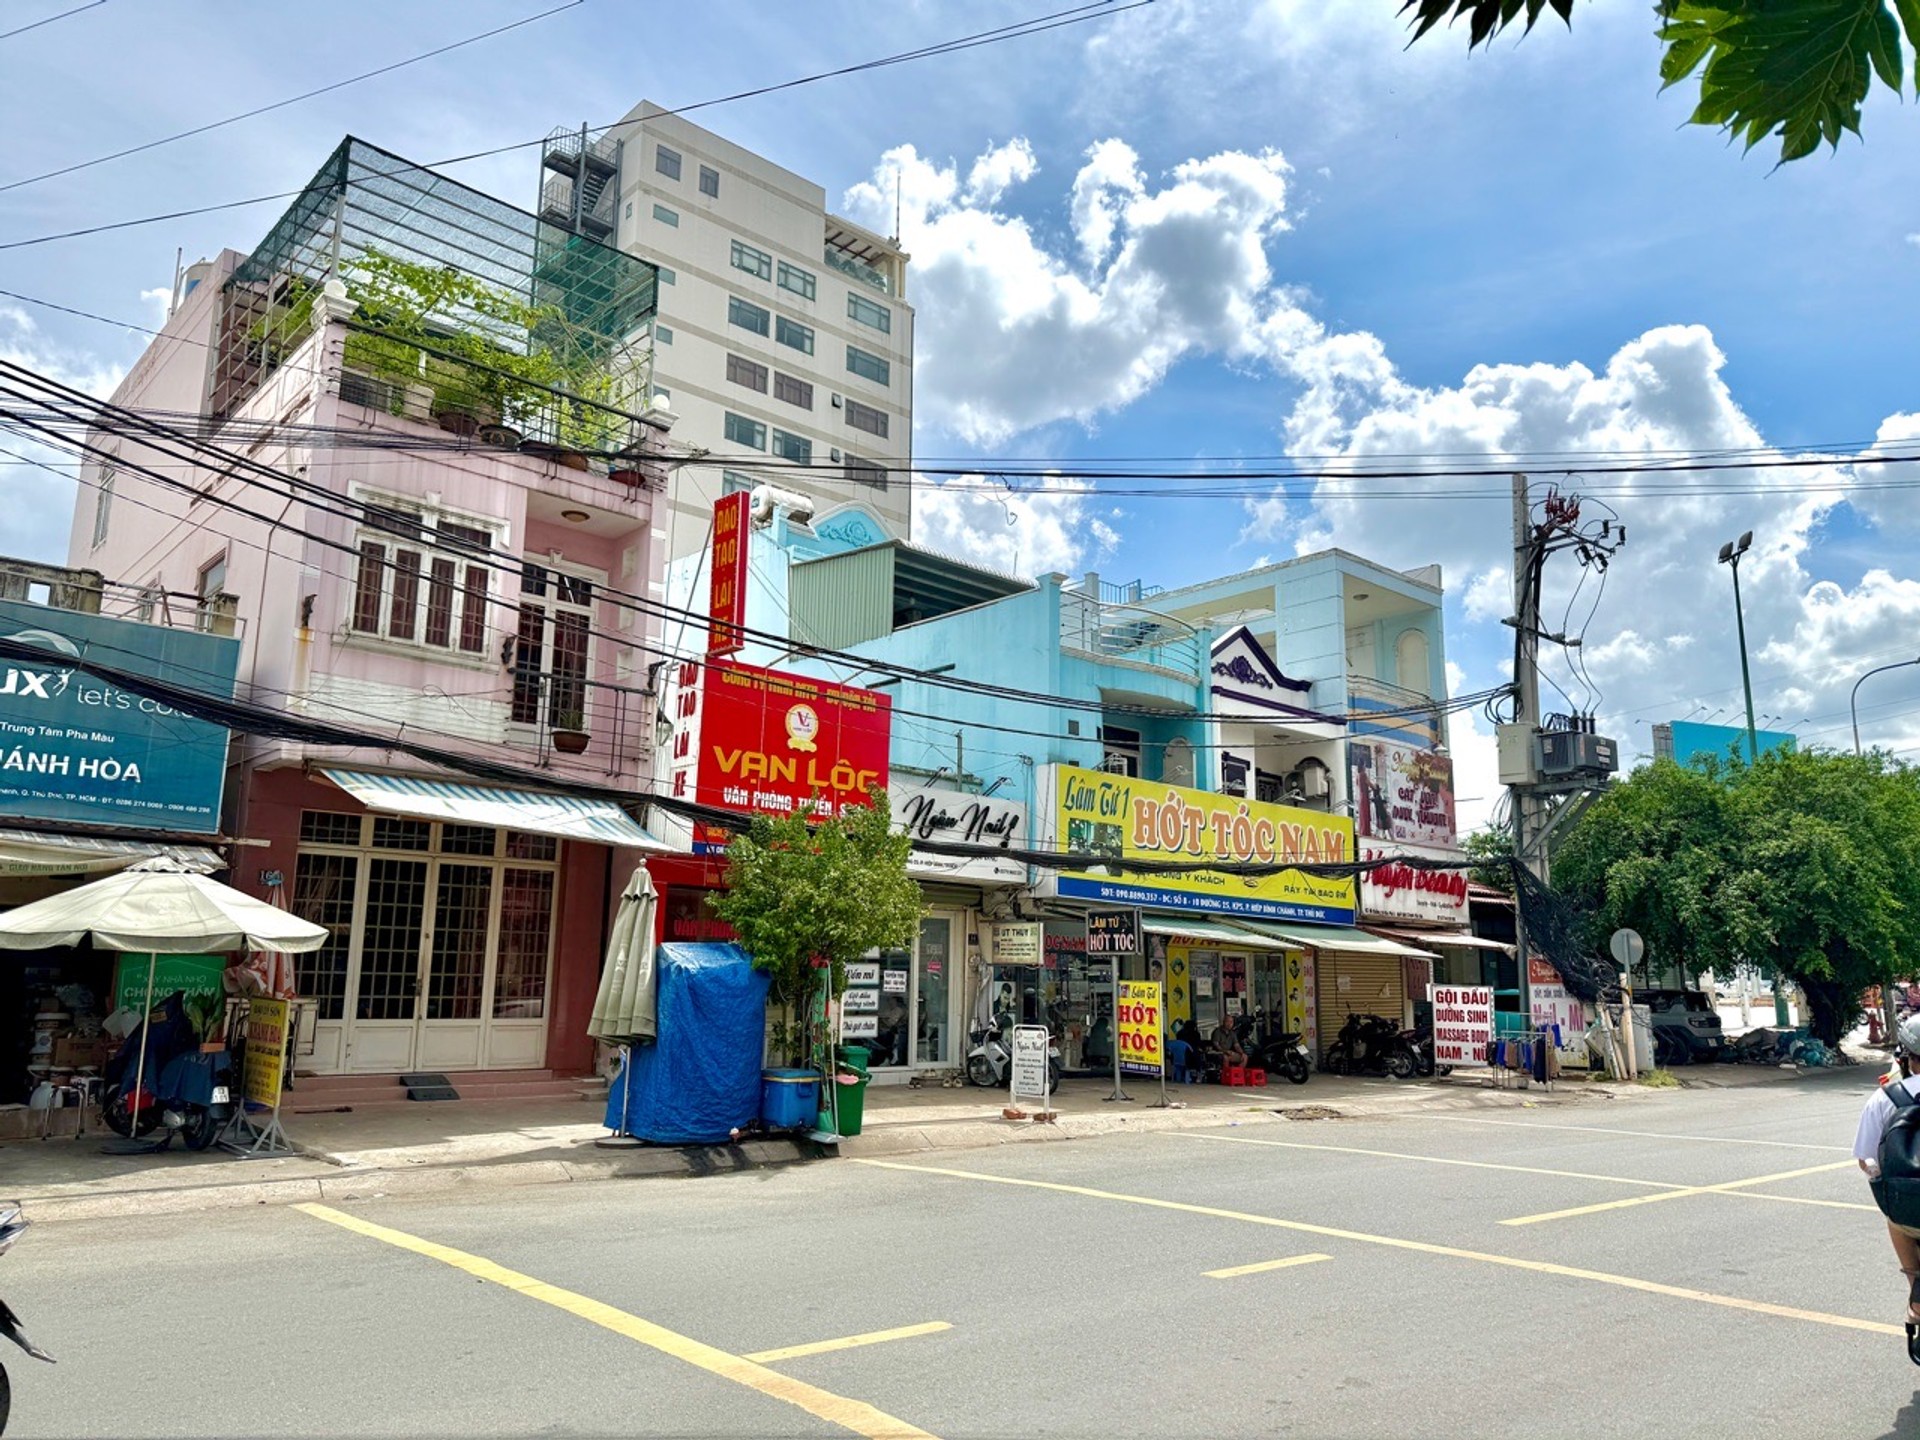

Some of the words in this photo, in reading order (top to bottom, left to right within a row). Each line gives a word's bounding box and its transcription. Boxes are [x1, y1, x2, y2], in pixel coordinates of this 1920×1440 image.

[717, 503, 737, 536] ĐÀO
[715, 538, 736, 571] TẠO
[77, 684, 131, 710] let's
[1, 721, 35, 737] Trung
[38, 724, 64, 738] Tâm
[66, 728, 89, 741] Pha
[91, 731, 115, 744] Màu
[0, 746, 70, 776] ÁNH
[78, 756, 142, 784] HÒA
[713, 745, 797, 785] VẠN
[807, 759, 880, 796] LỘC
[674, 771, 687, 797] XE
[1062, 775, 1096, 812] Lâm
[723, 786, 749, 806] VĂN
[752, 790, 792, 811] PHÒNG
[1131, 789, 1206, 858] HỚT
[1209, 802, 1276, 864] TÓC
[1279, 823, 1347, 865] NAM
[1090, 930, 1111, 951] HỚT
[1113, 929, 1135, 951] TÓC
[124, 986, 174, 998] CHNG
[1435, 989, 1458, 1005] GỘI
[1461, 987, 1488, 1005] ĐẦU
[1117, 1000, 1158, 1026] HỚT
[1467, 1010, 1489, 1024] SINH
[1118, 1027, 1158, 1054] TÓC
[1436, 1027, 1470, 1042] MASSAGE
[1471, 1028, 1489, 1043] BODY
[1436, 1045, 1462, 1060] NAM
